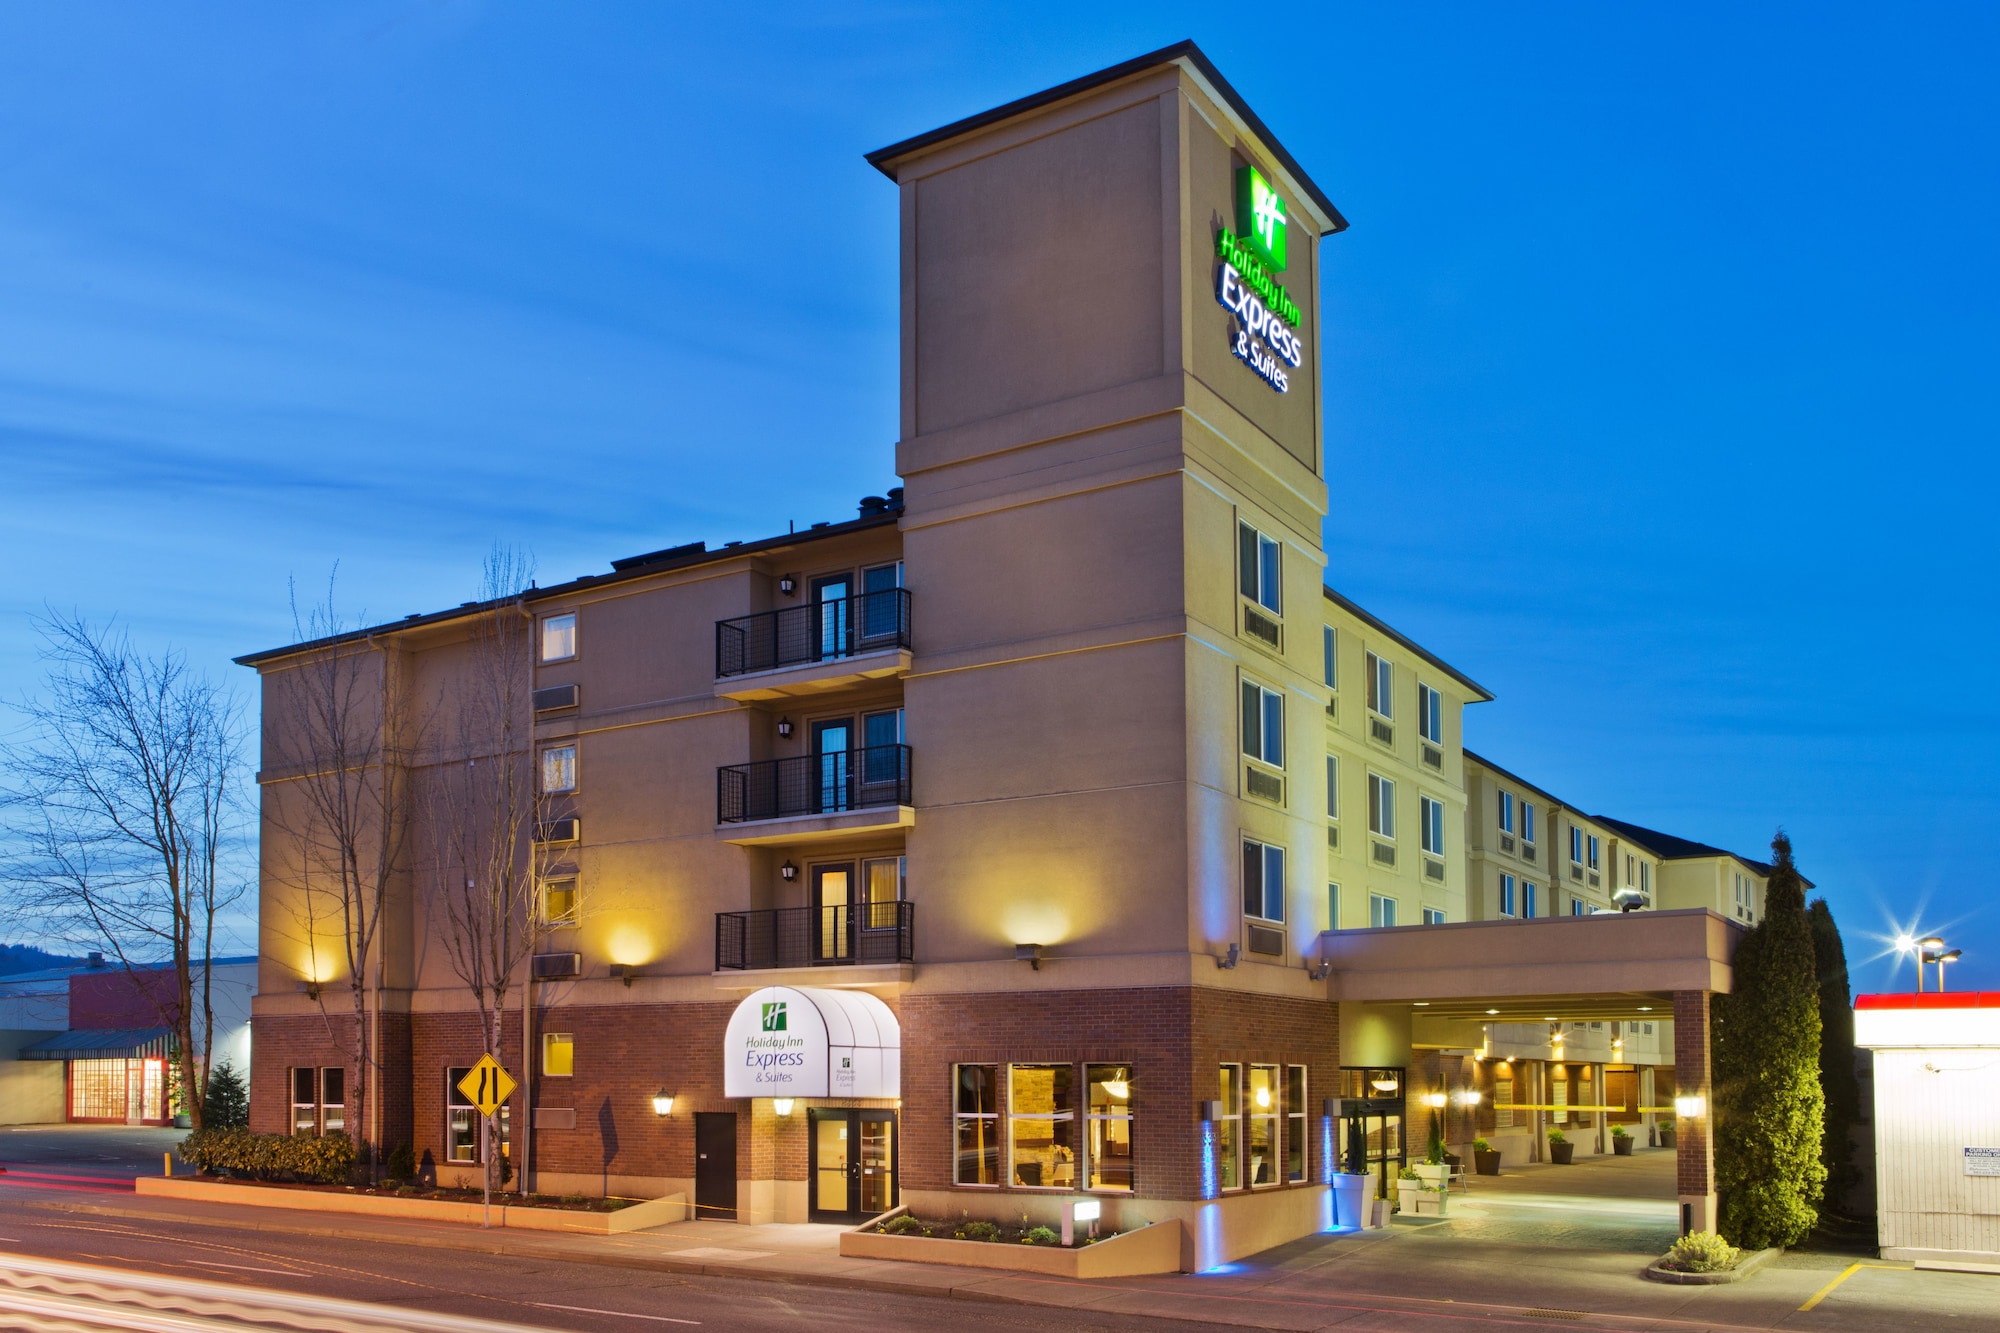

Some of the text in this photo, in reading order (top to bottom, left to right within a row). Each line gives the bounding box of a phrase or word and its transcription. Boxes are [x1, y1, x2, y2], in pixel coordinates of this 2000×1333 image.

[1220, 227, 1301, 328] Holiday Inn
[1221, 262, 1302, 368] Express
[1236, 330, 1288, 393] & Suites
[745, 1050, 804, 1071] Express
[746, 1035, 804, 1050] Holiday Inn
[755, 1071, 793, 1083] & Suites
